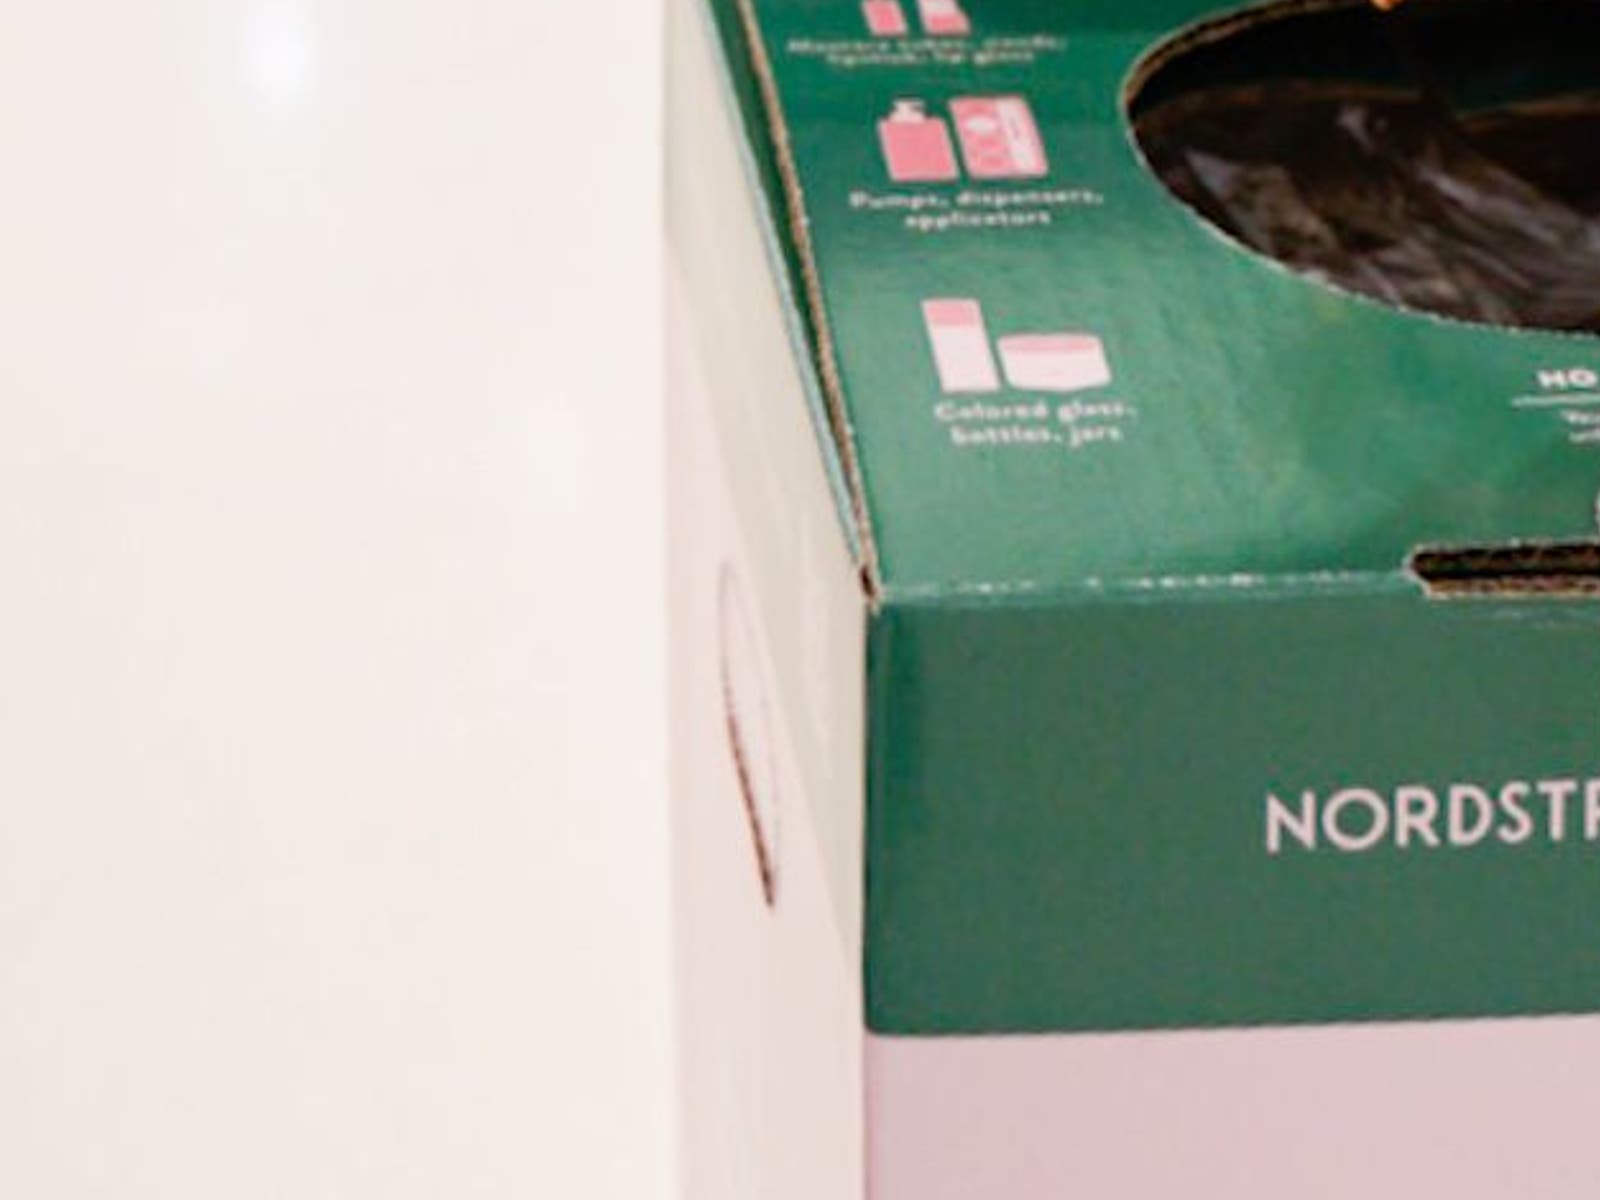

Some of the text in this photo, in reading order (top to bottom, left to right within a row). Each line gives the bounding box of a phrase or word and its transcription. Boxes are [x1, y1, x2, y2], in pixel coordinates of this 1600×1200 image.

[905, 211, 1050, 233] applicators
[1536, 367, 1598, 389] NO
[934, 400, 1048, 421] Colored
[1067, 425, 1123, 448] jars
